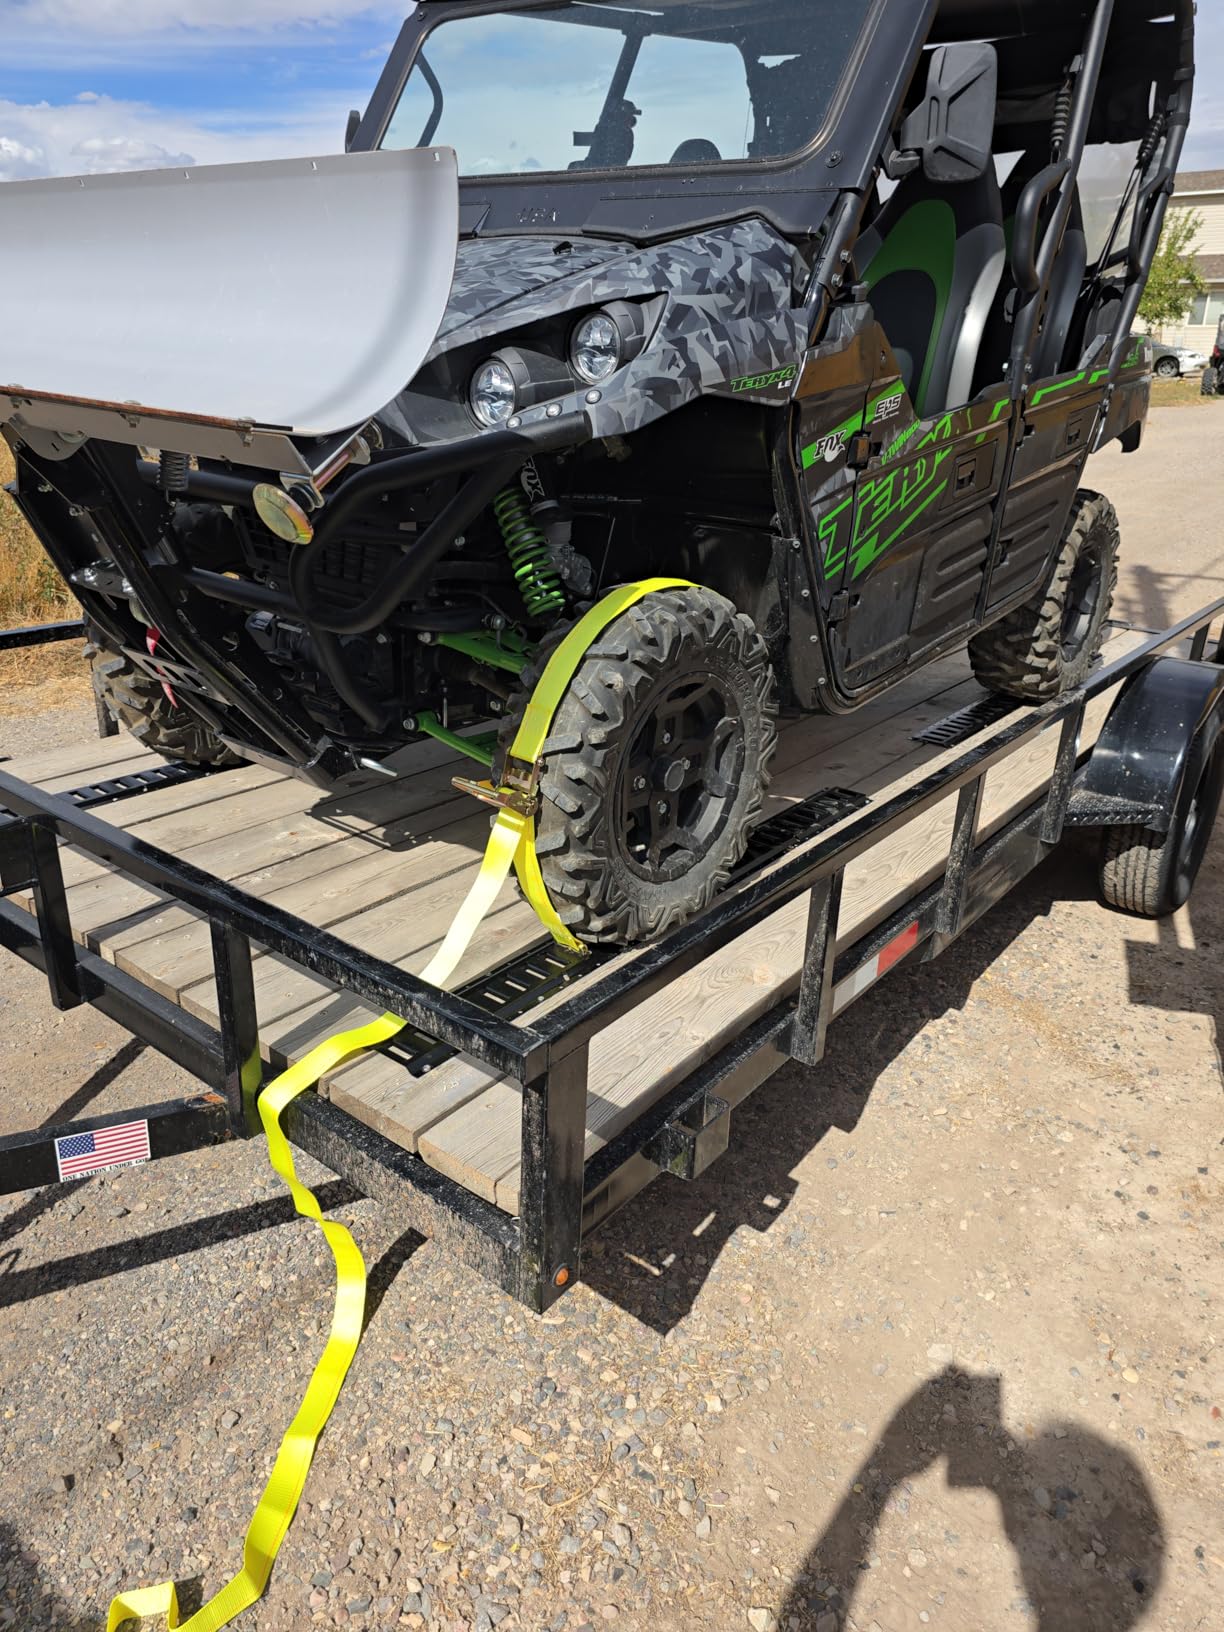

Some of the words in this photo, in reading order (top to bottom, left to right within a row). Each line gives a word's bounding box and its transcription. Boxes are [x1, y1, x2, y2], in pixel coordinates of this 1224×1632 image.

[731, 364, 796, 392] TERYX4
[777, 379, 793, 390] LE
[875, 393, 902, 418] EPS
[813, 429, 847, 461] FOX
[63, 1174, 78, 1182] ONE
[80, 1168, 106, 1178] NATION
[109, 1161, 132, 1171] UNDER
